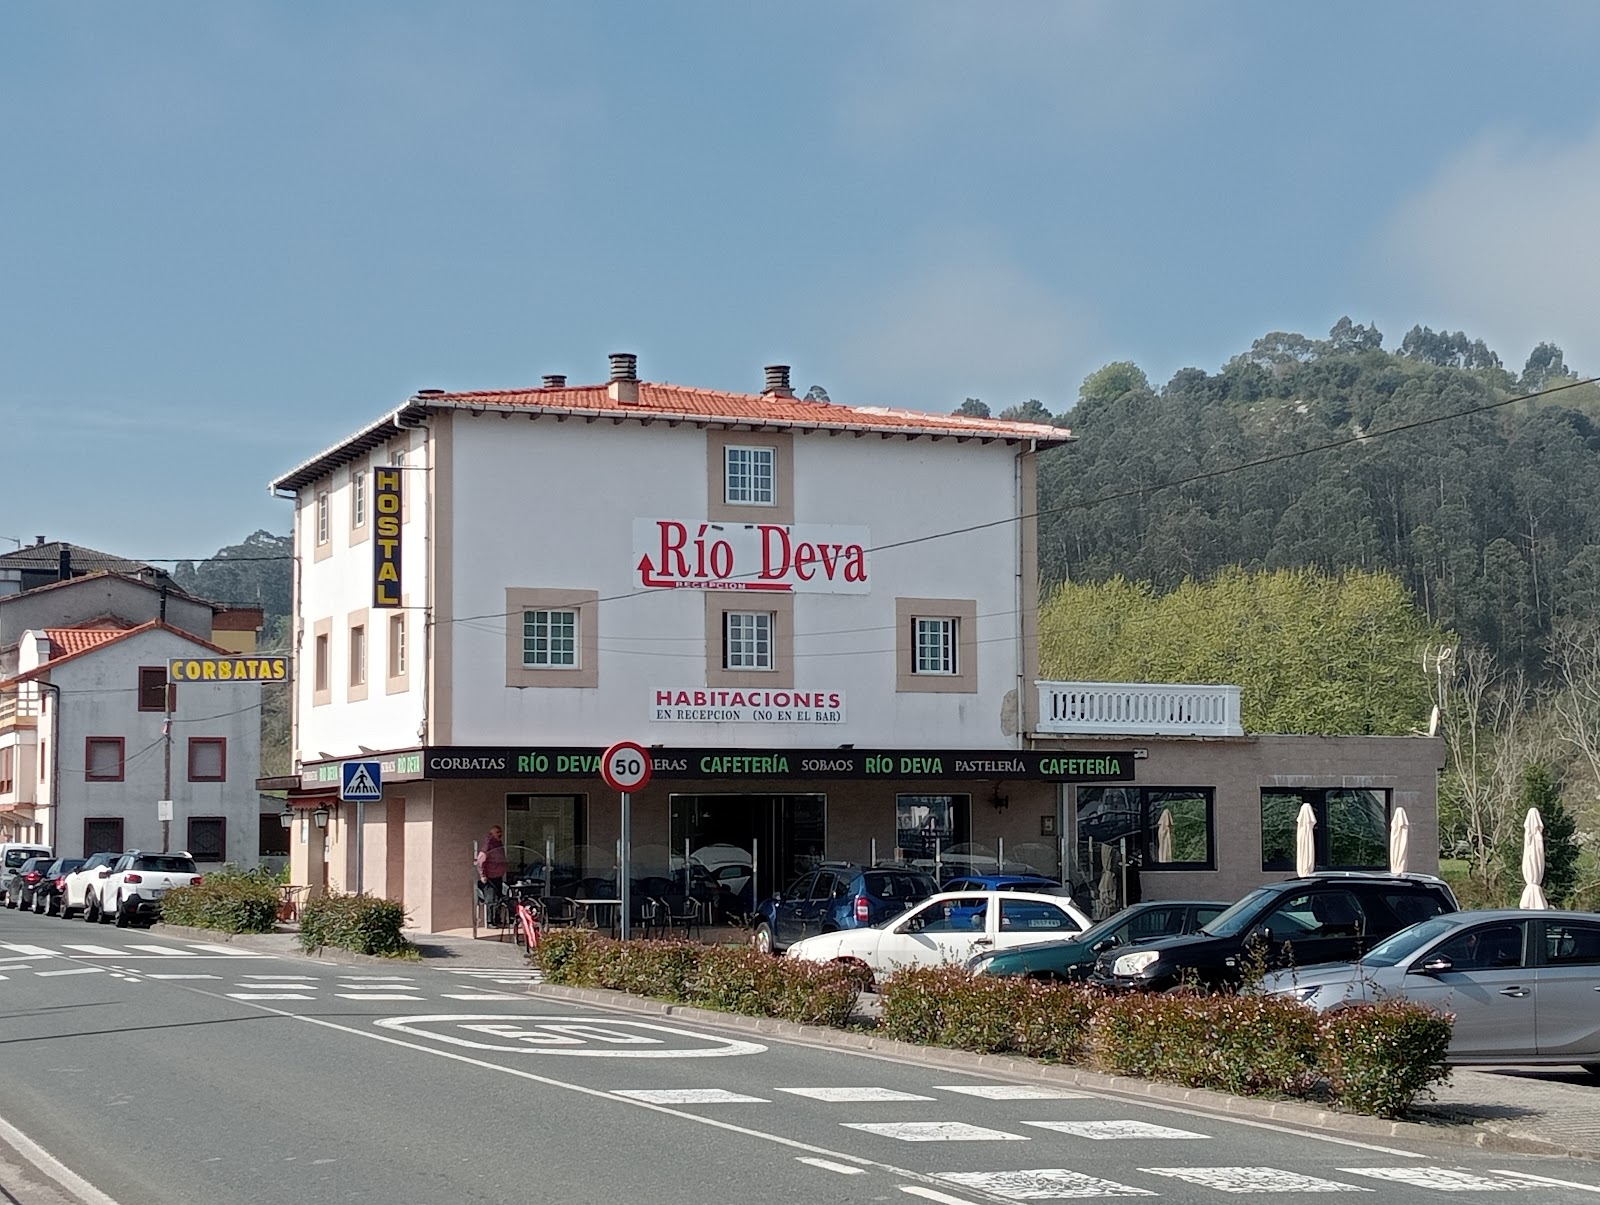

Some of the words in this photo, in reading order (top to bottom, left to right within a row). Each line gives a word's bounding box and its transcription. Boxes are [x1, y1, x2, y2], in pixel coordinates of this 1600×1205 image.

[378, 471, 399, 604] HOSTAL
[656, 521, 734, 579] Río
[757, 525, 868, 583] Deva
[675, 581, 746, 590] RECEPCION
[171, 659, 285, 680] CORBATAS
[656, 691, 841, 708] HABITACIONES
[656, 710, 672, 720] EN
[677, 710, 741, 720] RECEPCION
[753, 710, 773, 721] (NO
[778, 711, 792, 721] EN
[797, 711, 811, 721] EL
[815, 711, 841, 722] BAR)
[430, 757, 506, 770] CORBATAS
[517, 752, 549, 773] RÍO
[556, 755, 602, 773] DEVA
[649, 757, 688, 771] ERAS
[700, 753, 789, 774] CAFETERÍA
[801, 759, 854, 771] SOBAOS
[865, 754, 894, 774] RÍO
[900, 757, 943, 774] DEVA
[955, 758, 1026, 772] PASTELERÍA
[1039, 756, 1121, 775] CAFETERÍA
[615, 759, 640, 775] 50
[456, 1024, 665, 1045] 50
